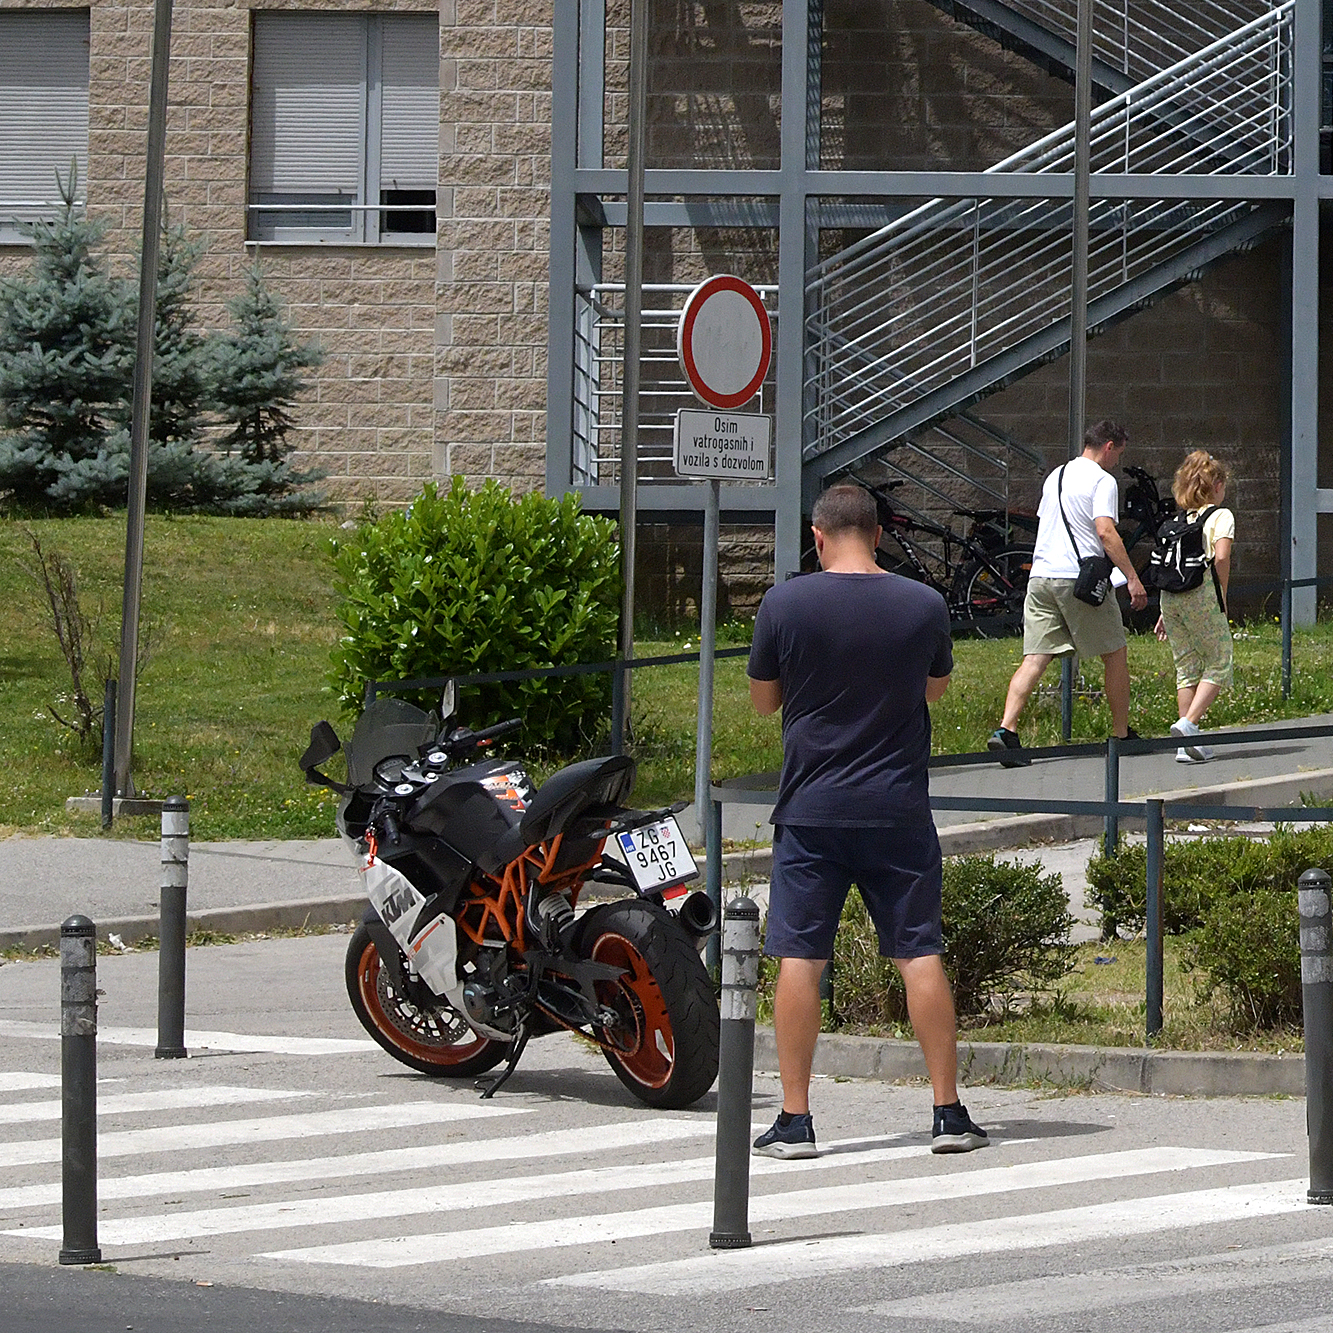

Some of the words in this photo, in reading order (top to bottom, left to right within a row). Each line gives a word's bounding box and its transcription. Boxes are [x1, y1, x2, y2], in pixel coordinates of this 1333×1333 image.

[714, 417, 738, 433] Osim
[693, 434, 748, 454] vatrogasnih
[750, 437, 754, 452] i
[683, 452, 710, 467] vozila
[713, 456, 718, 468] s
[721, 454, 764, 471] dozvolom
[636, 828, 659, 849] ZG
[636, 840, 676, 868] 9467
[658, 861, 677, 881] JG
[381, 886, 417, 928] KTM
